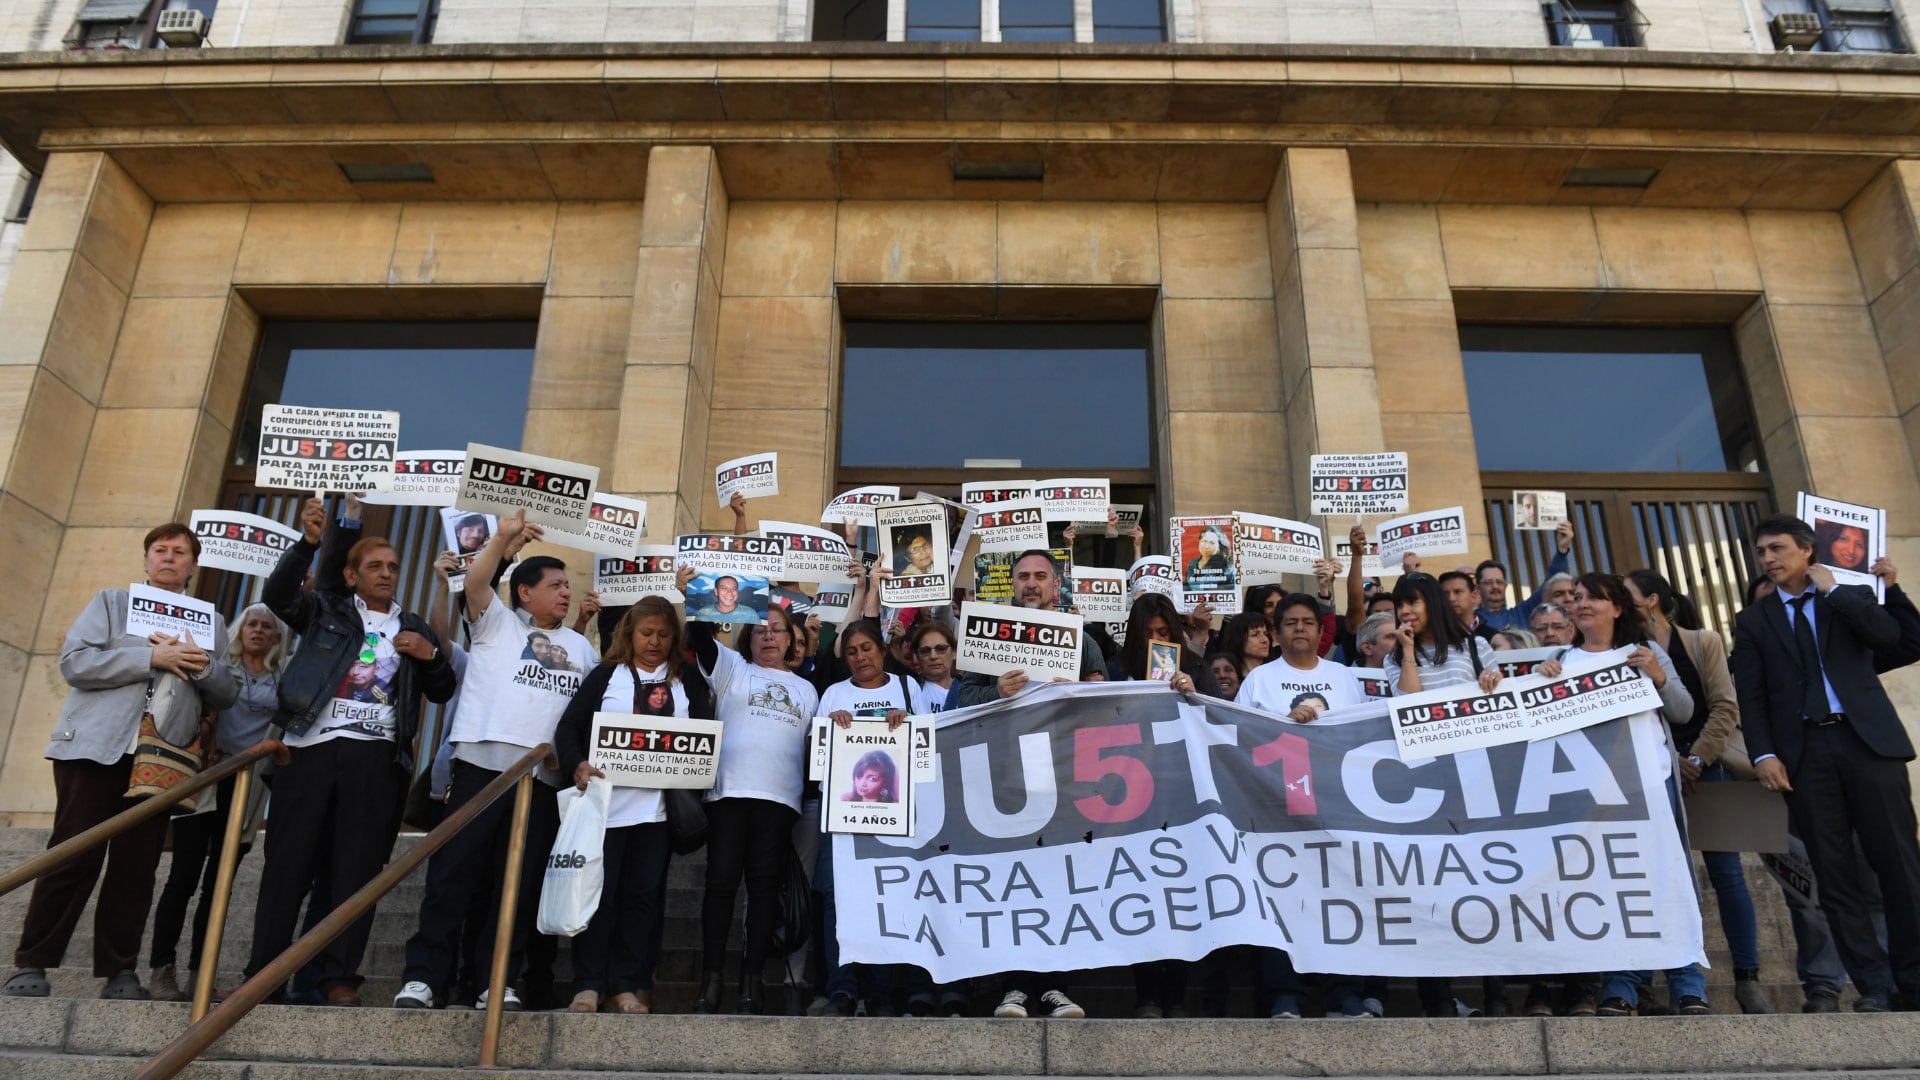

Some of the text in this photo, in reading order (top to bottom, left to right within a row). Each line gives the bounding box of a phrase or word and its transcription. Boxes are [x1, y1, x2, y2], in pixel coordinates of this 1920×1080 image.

[296, 408, 320, 417] CARA
[358, 412, 369, 420] DE
[270, 416, 328, 427] CORRUPCIÓN
[331, 420, 341, 428] ES
[357, 422, 392, 430] MUERTE
[286, 427, 331, 437] COMPLICE
[346, 430, 355, 438] EL
[358, 431, 397, 439] SILENCIO
[260, 459, 389, 473] PARA MI ESPOSA
[285, 470, 364, 481] TATIANA Y
[410, 474, 455, 484] VÍCTIMAS
[269, 477, 377, 490] MI HIJA HUMA
[467, 482, 585, 510] PARA LAS VÍCTIMAS DE
[465, 491, 478, 499] LA
[481, 493, 533, 508] TRAGEDIA
[536, 504, 550, 513] DE
[553, 508, 583, 520] ONCE
[885, 508, 920, 518] JUSTICIA
[1814, 504, 1869, 523] ESTHER
[880, 514, 944, 526] MARIA SCIDONE
[996, 526, 1031, 534] VÍCTIMAS
[593, 532, 633, 548] DE ONCE
[1247, 551, 1287, 560] TRAGEDIA
[1275, 545, 1311, 555] VÍCTIMAS
[205, 548, 270, 566] TRAGEDIA DE
[678, 552, 701, 560] PARA
[704, 552, 721, 560] LAS
[724, 553, 768, 563] VÍCTIMAS
[806, 553, 840, 562] VÍCTIMAS
[690, 560, 783, 573] TRAGEDIA DE ONCE
[599, 577, 619, 585] PARA
[610, 585, 653, 593] TRAGEDIA
[1074, 594, 1110, 603] VÍCTIMAS
[131, 611, 151, 619] PARA
[168, 617, 200, 629] VÍCTIMAS
[142, 619, 178, 630] TRAGEDIA
[964, 639, 1075, 660] PARA LAS VÍCTIMAS DE
[963, 649, 1075, 671] LA TRAGEDIA DE ONCE
[513, 675, 527, 686] POR
[528, 678, 552, 691] MATIAS
[518, 664, 580, 689] JUSTICIA
[1281, 682, 1332, 692] MONICA
[1555, 680, 1646, 710] LAS VÍCTIMAS DE
[854, 700, 892, 710] KARINA
[1543, 690, 1651, 724] TRAGEDIA DE ONCE
[1402, 711, 1520, 736] PARA LAS VÍCTIMAS DE
[846, 735, 897, 745] KARINA
[1404, 720, 1524, 747] LA TRAGEDIA DE ONCE
[596, 751, 712, 766] PARA LAS VÍCTIMAS DE
[610, 763, 711, 776] TRAGEDIA DE ONCE
[843, 814, 897, 825] 14 AÑOS
[874, 860, 1043, 904] PARA
[1064, 836, 1188, 896] LAS
[1551, 832, 1647, 881] DE
[876, 902, 945, 957] LA
[1321, 896, 1417, 946] DE
[1450, 889, 1662, 945] ONCE
